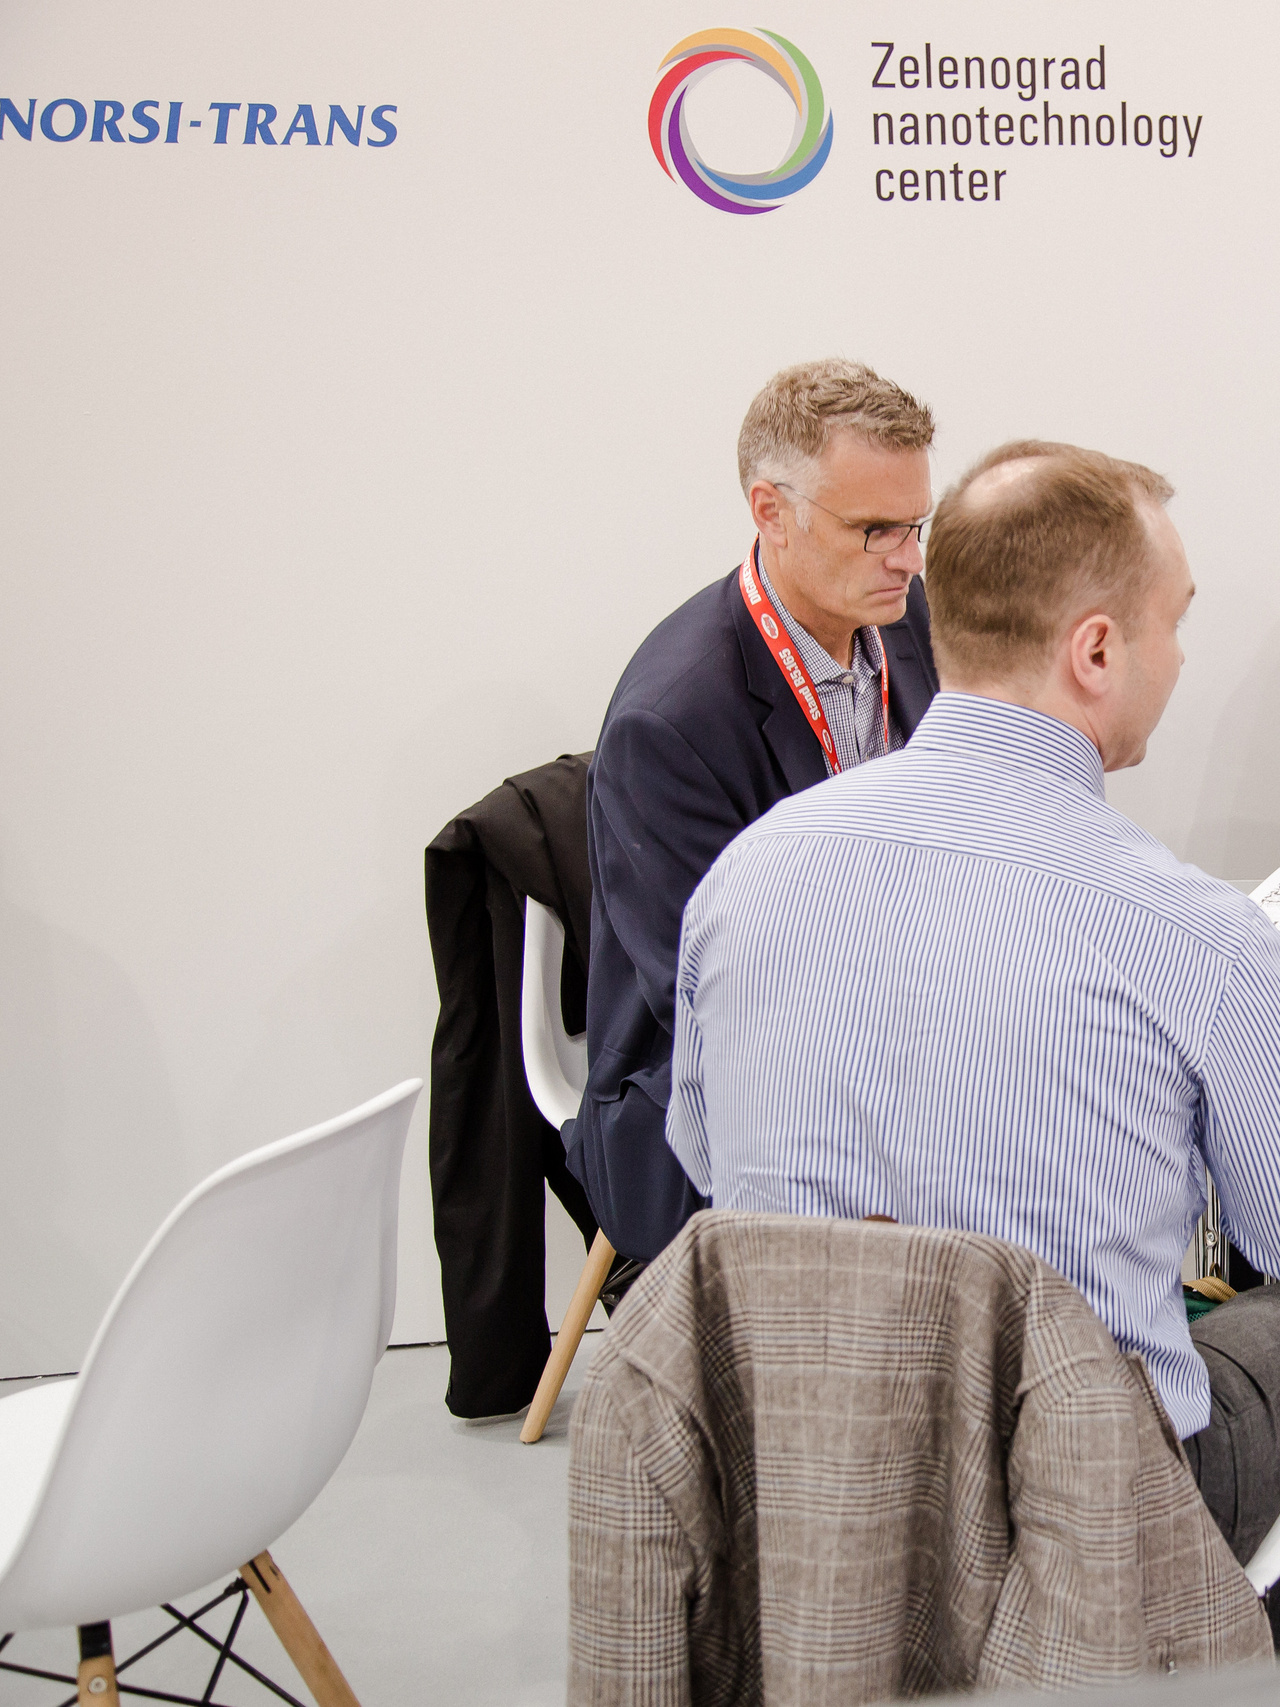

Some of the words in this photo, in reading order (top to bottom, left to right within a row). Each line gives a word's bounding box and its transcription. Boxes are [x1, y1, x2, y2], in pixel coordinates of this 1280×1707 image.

[870, 41, 1107, 102] Zelenograd
[0, 97, 399, 148] NORSI-TRANS
[872, 100, 1204, 158] nanotechnology
[874, 162, 1008, 202] center
[778, 647, 806, 688] B5.165
[798, 685, 822, 721] Stand
